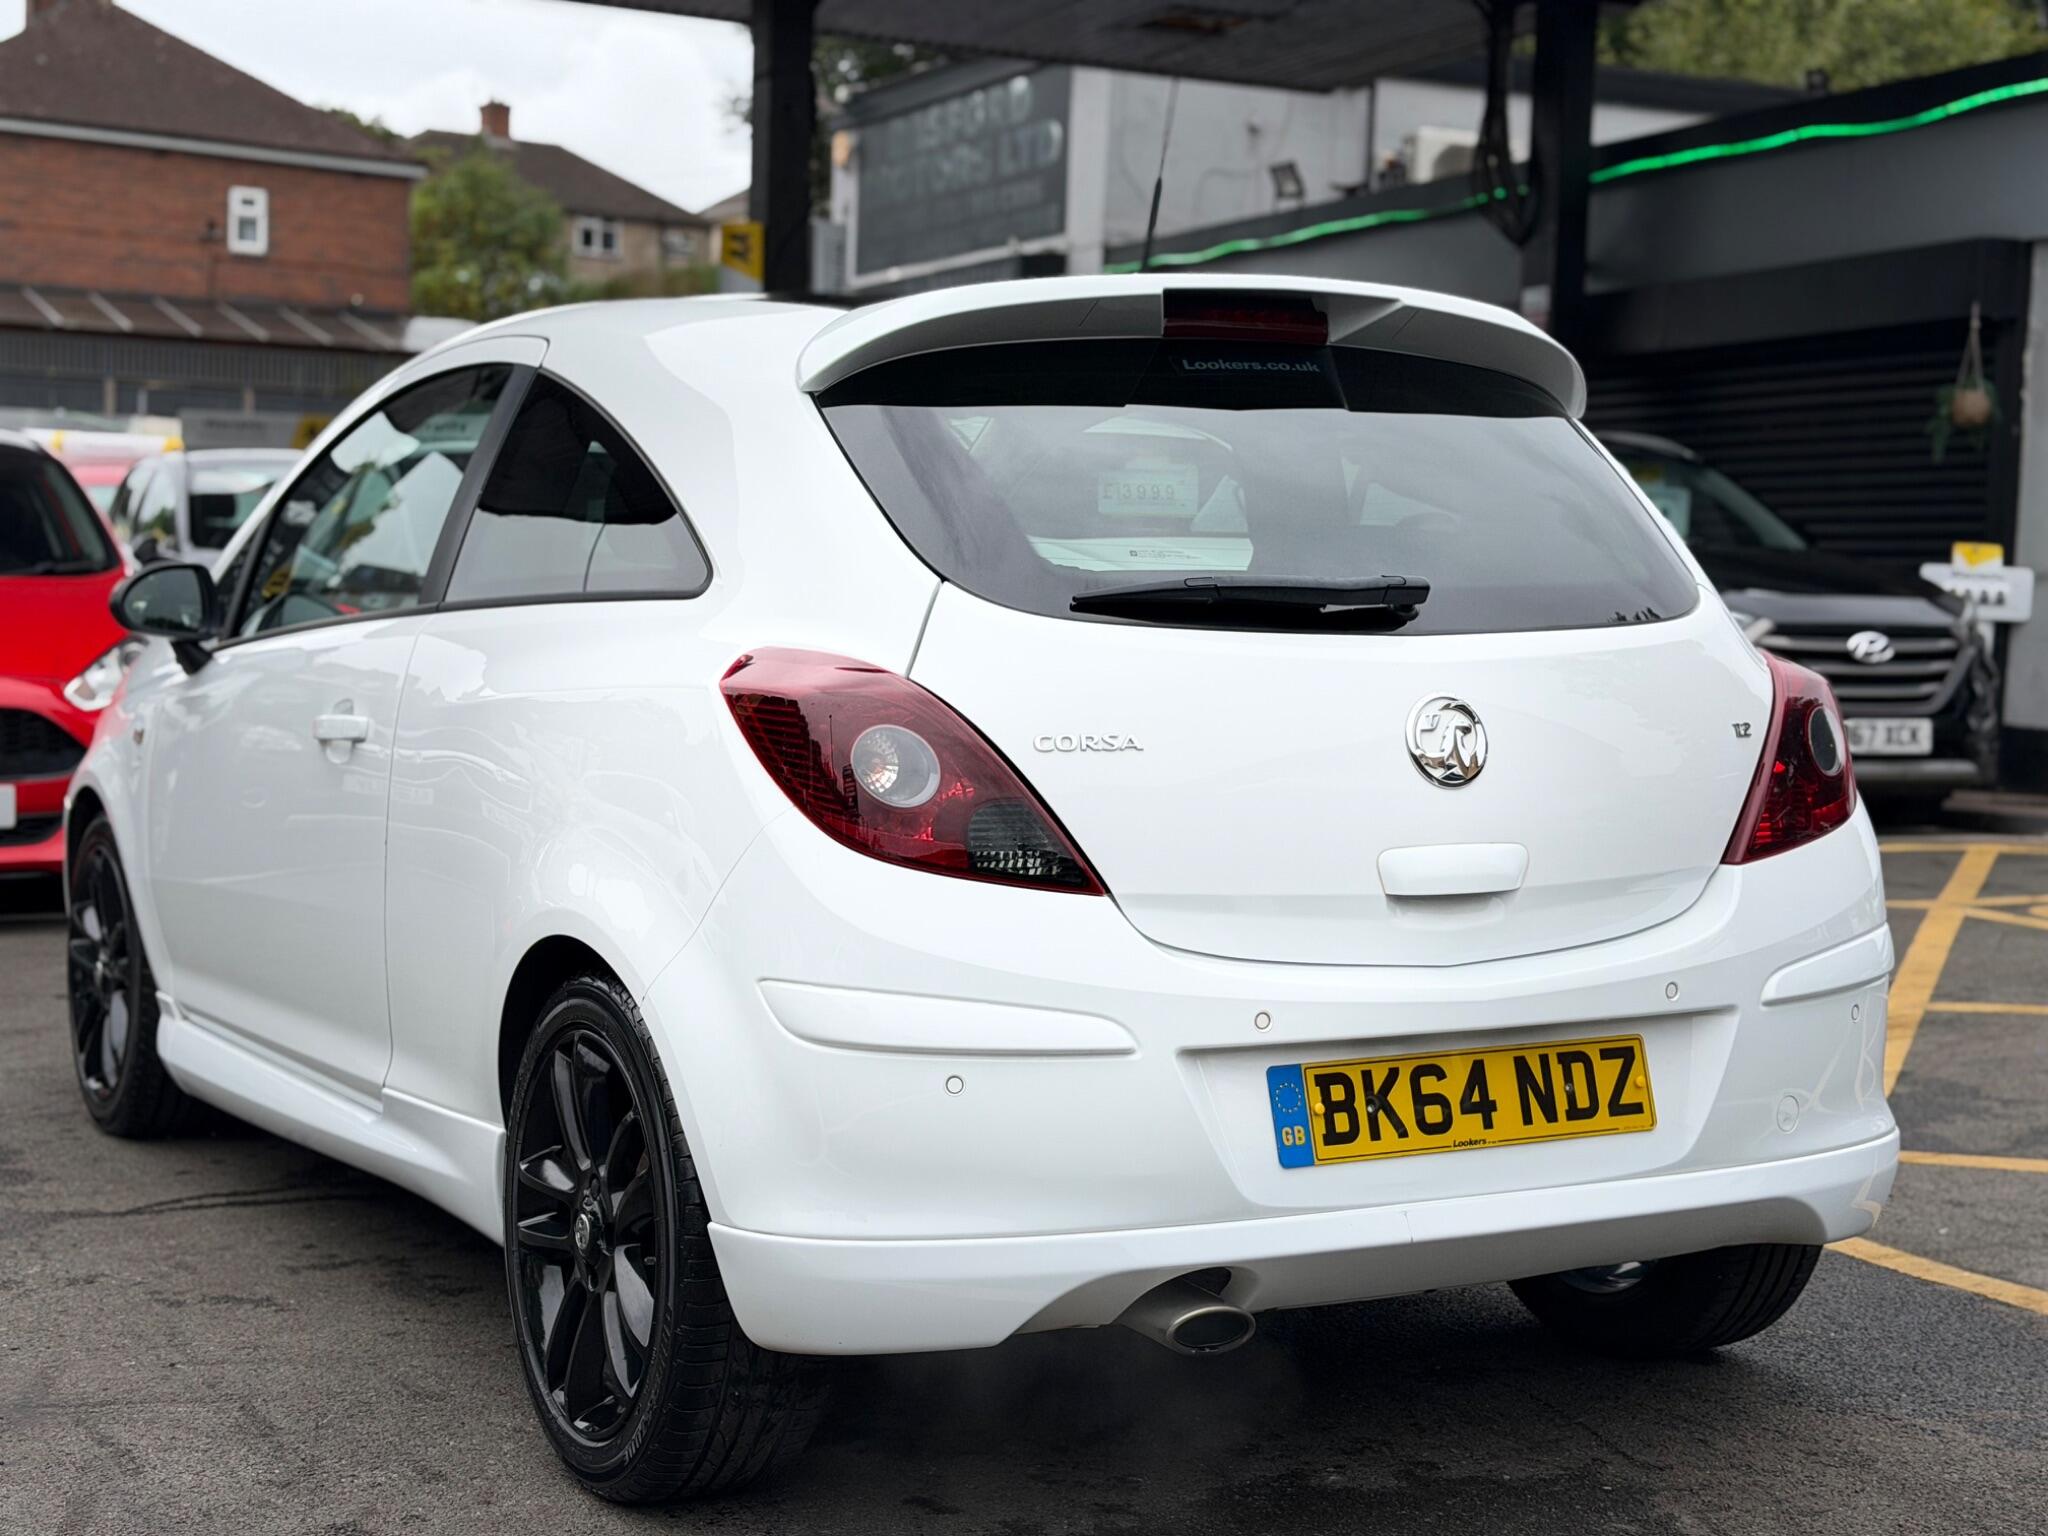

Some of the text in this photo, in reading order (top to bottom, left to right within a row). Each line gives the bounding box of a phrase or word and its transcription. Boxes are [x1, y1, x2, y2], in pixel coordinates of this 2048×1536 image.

[1182, 359, 1320, 373] Lookers.co.uk
[1033, 734, 1144, 753] CORSA
[1314, 1046, 1644, 1146] BK64 NDZ
[1282, 1125, 1306, 1146] GB
[1453, 1138, 1487, 1148] Lookers
